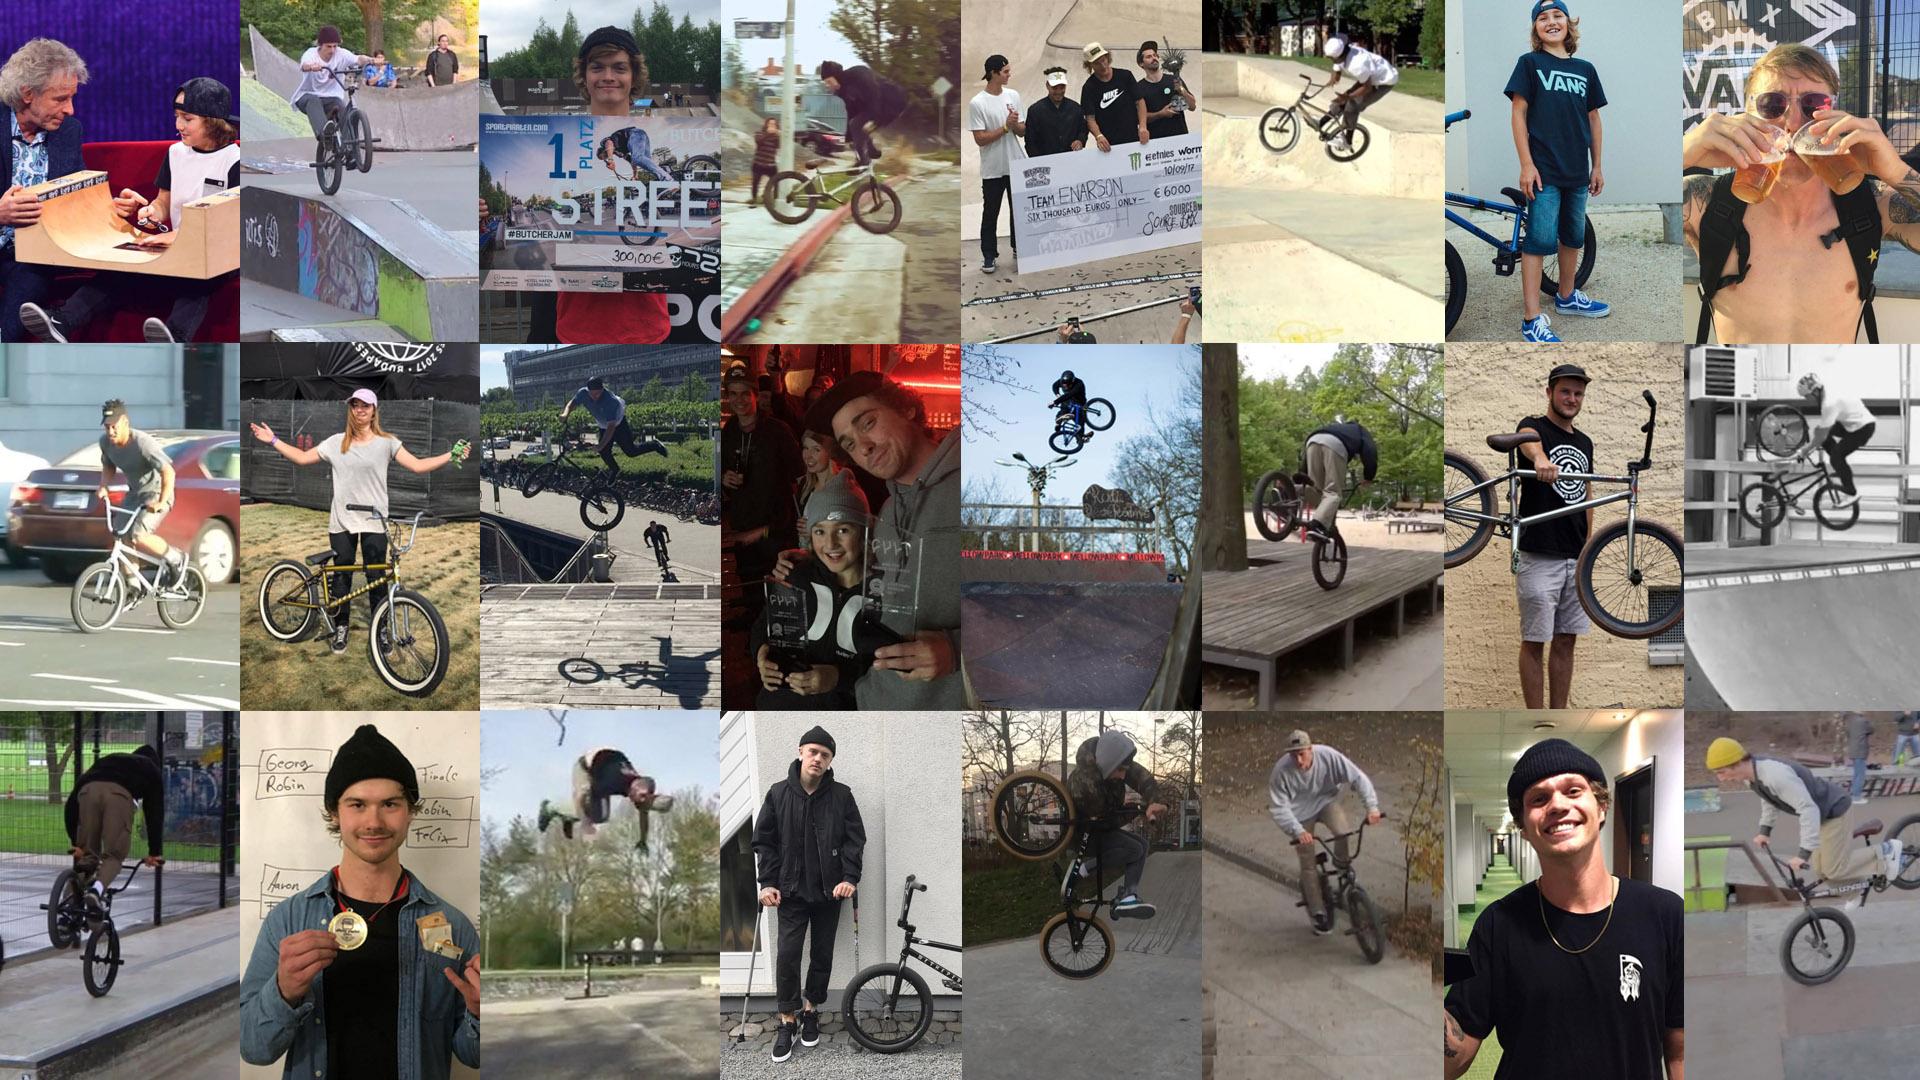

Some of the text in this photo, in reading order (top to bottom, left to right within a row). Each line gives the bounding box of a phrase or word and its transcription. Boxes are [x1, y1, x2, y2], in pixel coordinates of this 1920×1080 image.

[1536, 69, 1587, 97] VANS
[1103, 89, 1119, 100] NIKE
[579, 120, 594, 169] PLATZ
[548, 133, 577, 179] 1.
[1164, 163, 1195, 176] 10/09/17
[1027, 177, 1123, 209] TEAM ENARSON
[1163, 184, 1191, 197] 6000
[551, 180, 721, 229] STREE
[1027, 212, 1041, 223] SIX
[1043, 206, 1081, 219] THOUSAND
[1085, 200, 1111, 213] EUROS
[507, 230, 573, 240] #BUTCHERJAM
[416, 353, 438, 372] 2017
[266, 753, 314, 772] Georg
[266, 775, 306, 793] Robin
[411, 825, 458, 844] Felix
